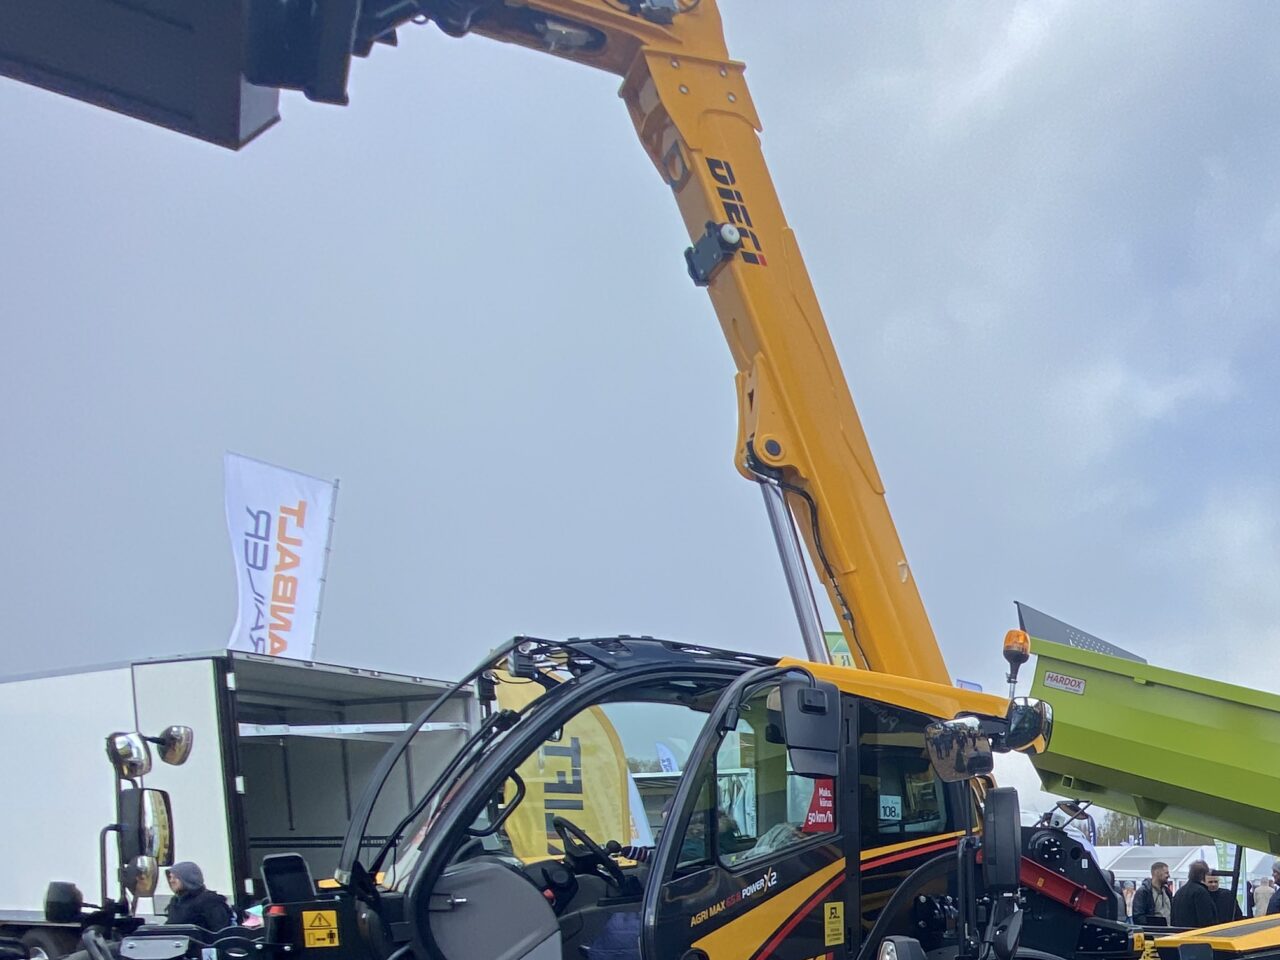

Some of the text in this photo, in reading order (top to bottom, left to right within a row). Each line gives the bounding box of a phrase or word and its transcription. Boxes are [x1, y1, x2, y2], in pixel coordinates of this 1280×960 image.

[1046, 673, 1083, 689] HARDOX
[882, 805, 897, 818] 108
[690, 912, 709, 928] AGRI
[709, 899, 726, 917] MAX
